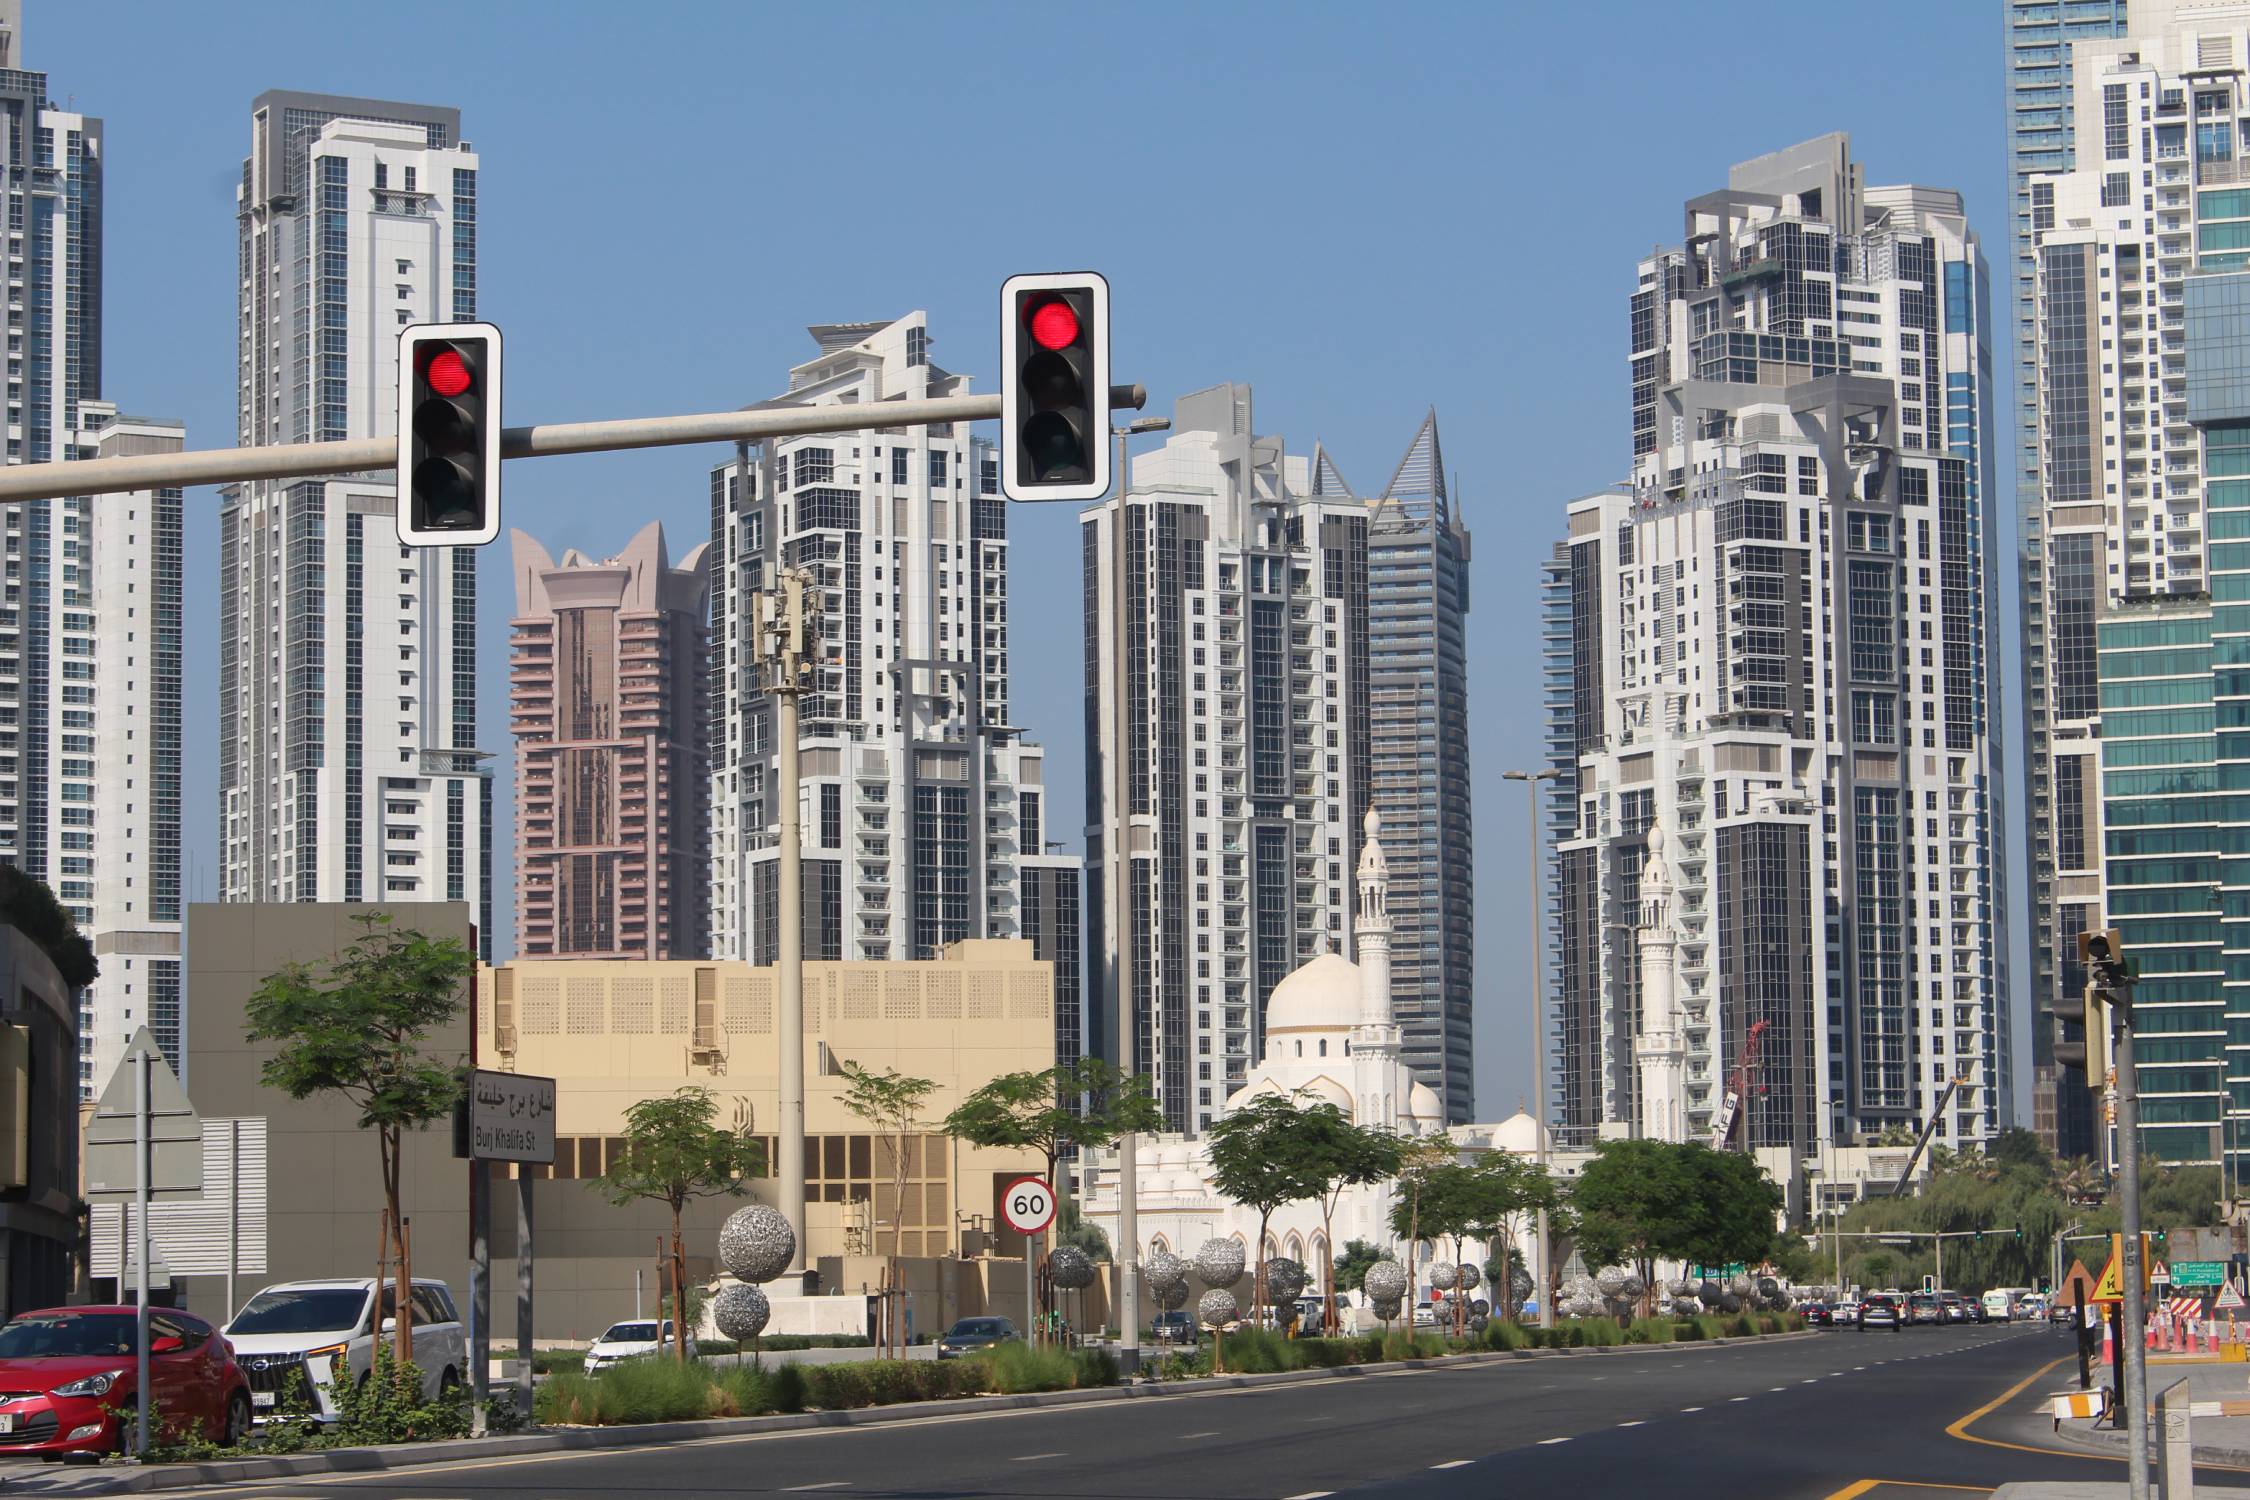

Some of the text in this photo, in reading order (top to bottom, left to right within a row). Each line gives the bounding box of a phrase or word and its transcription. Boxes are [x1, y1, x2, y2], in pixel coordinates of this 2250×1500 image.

[477, 1081, 552, 1119] شارع برج خليفة
[476, 1126, 536, 1153] Burj Khalifa St
[1014, 1195, 1044, 1215] 60
